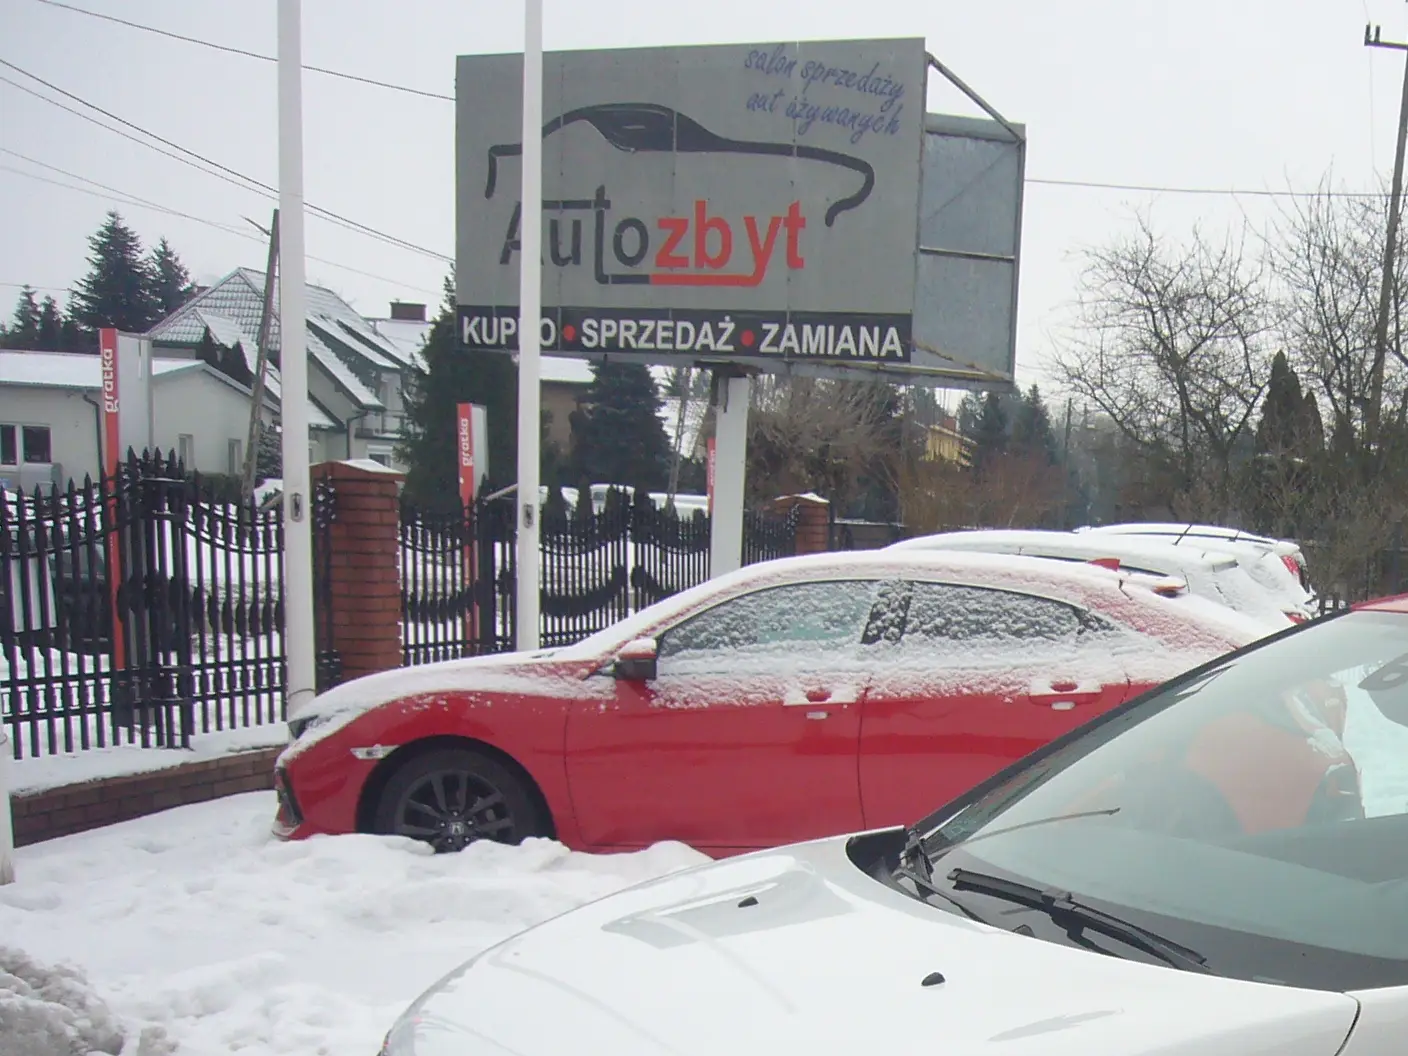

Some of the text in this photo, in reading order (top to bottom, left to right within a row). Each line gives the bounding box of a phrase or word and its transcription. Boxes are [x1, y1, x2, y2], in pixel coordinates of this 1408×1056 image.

[744, 43, 905, 112] salon sprzedaży
[746, 88, 785, 113] aut
[462, 315, 904, 357] KUPO SPRZEDAŻ ZAMIANA
[102, 348, 119, 413] gratka
